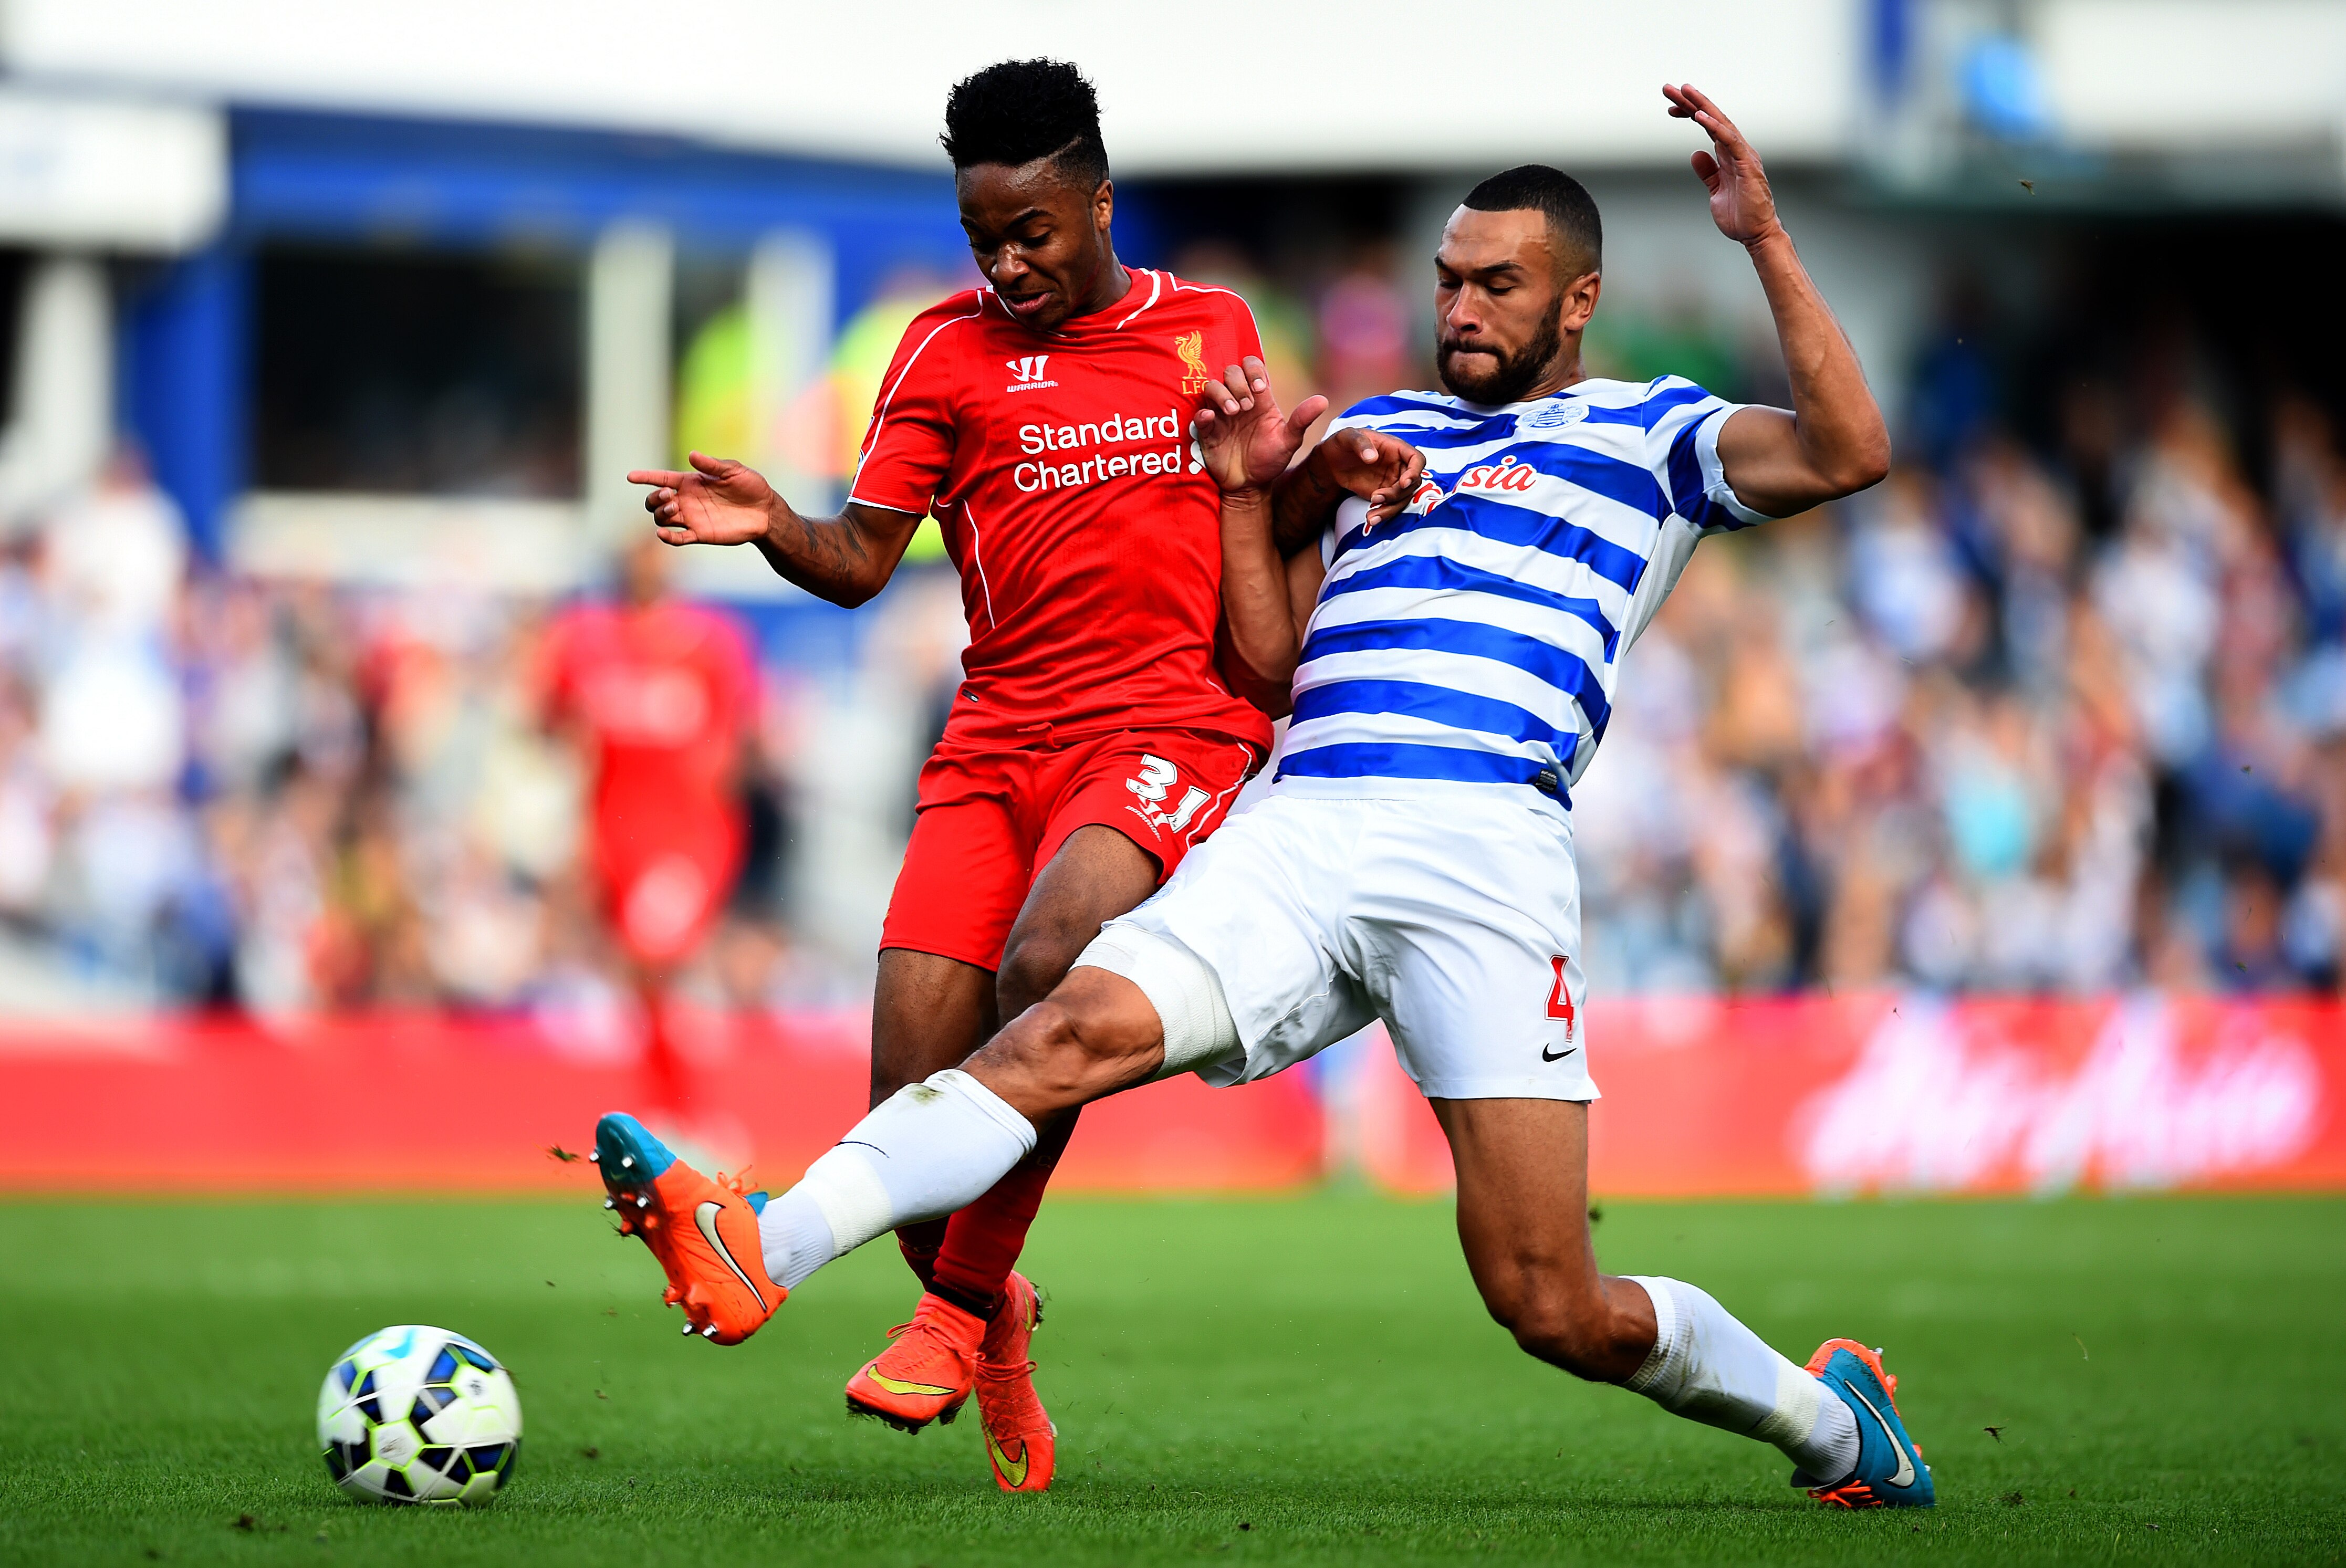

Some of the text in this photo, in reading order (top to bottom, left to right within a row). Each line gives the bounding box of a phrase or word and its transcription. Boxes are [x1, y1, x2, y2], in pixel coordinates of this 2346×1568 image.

[1006, 380, 1055, 393] WARRIOR
[1019, 409, 1179, 454] Standard
[1014, 445, 1181, 492] Chartered
[1125, 754, 1211, 833] 31
[1124, 805, 1162, 842] WARRIOR
[1544, 954, 1575, 1043] 4
